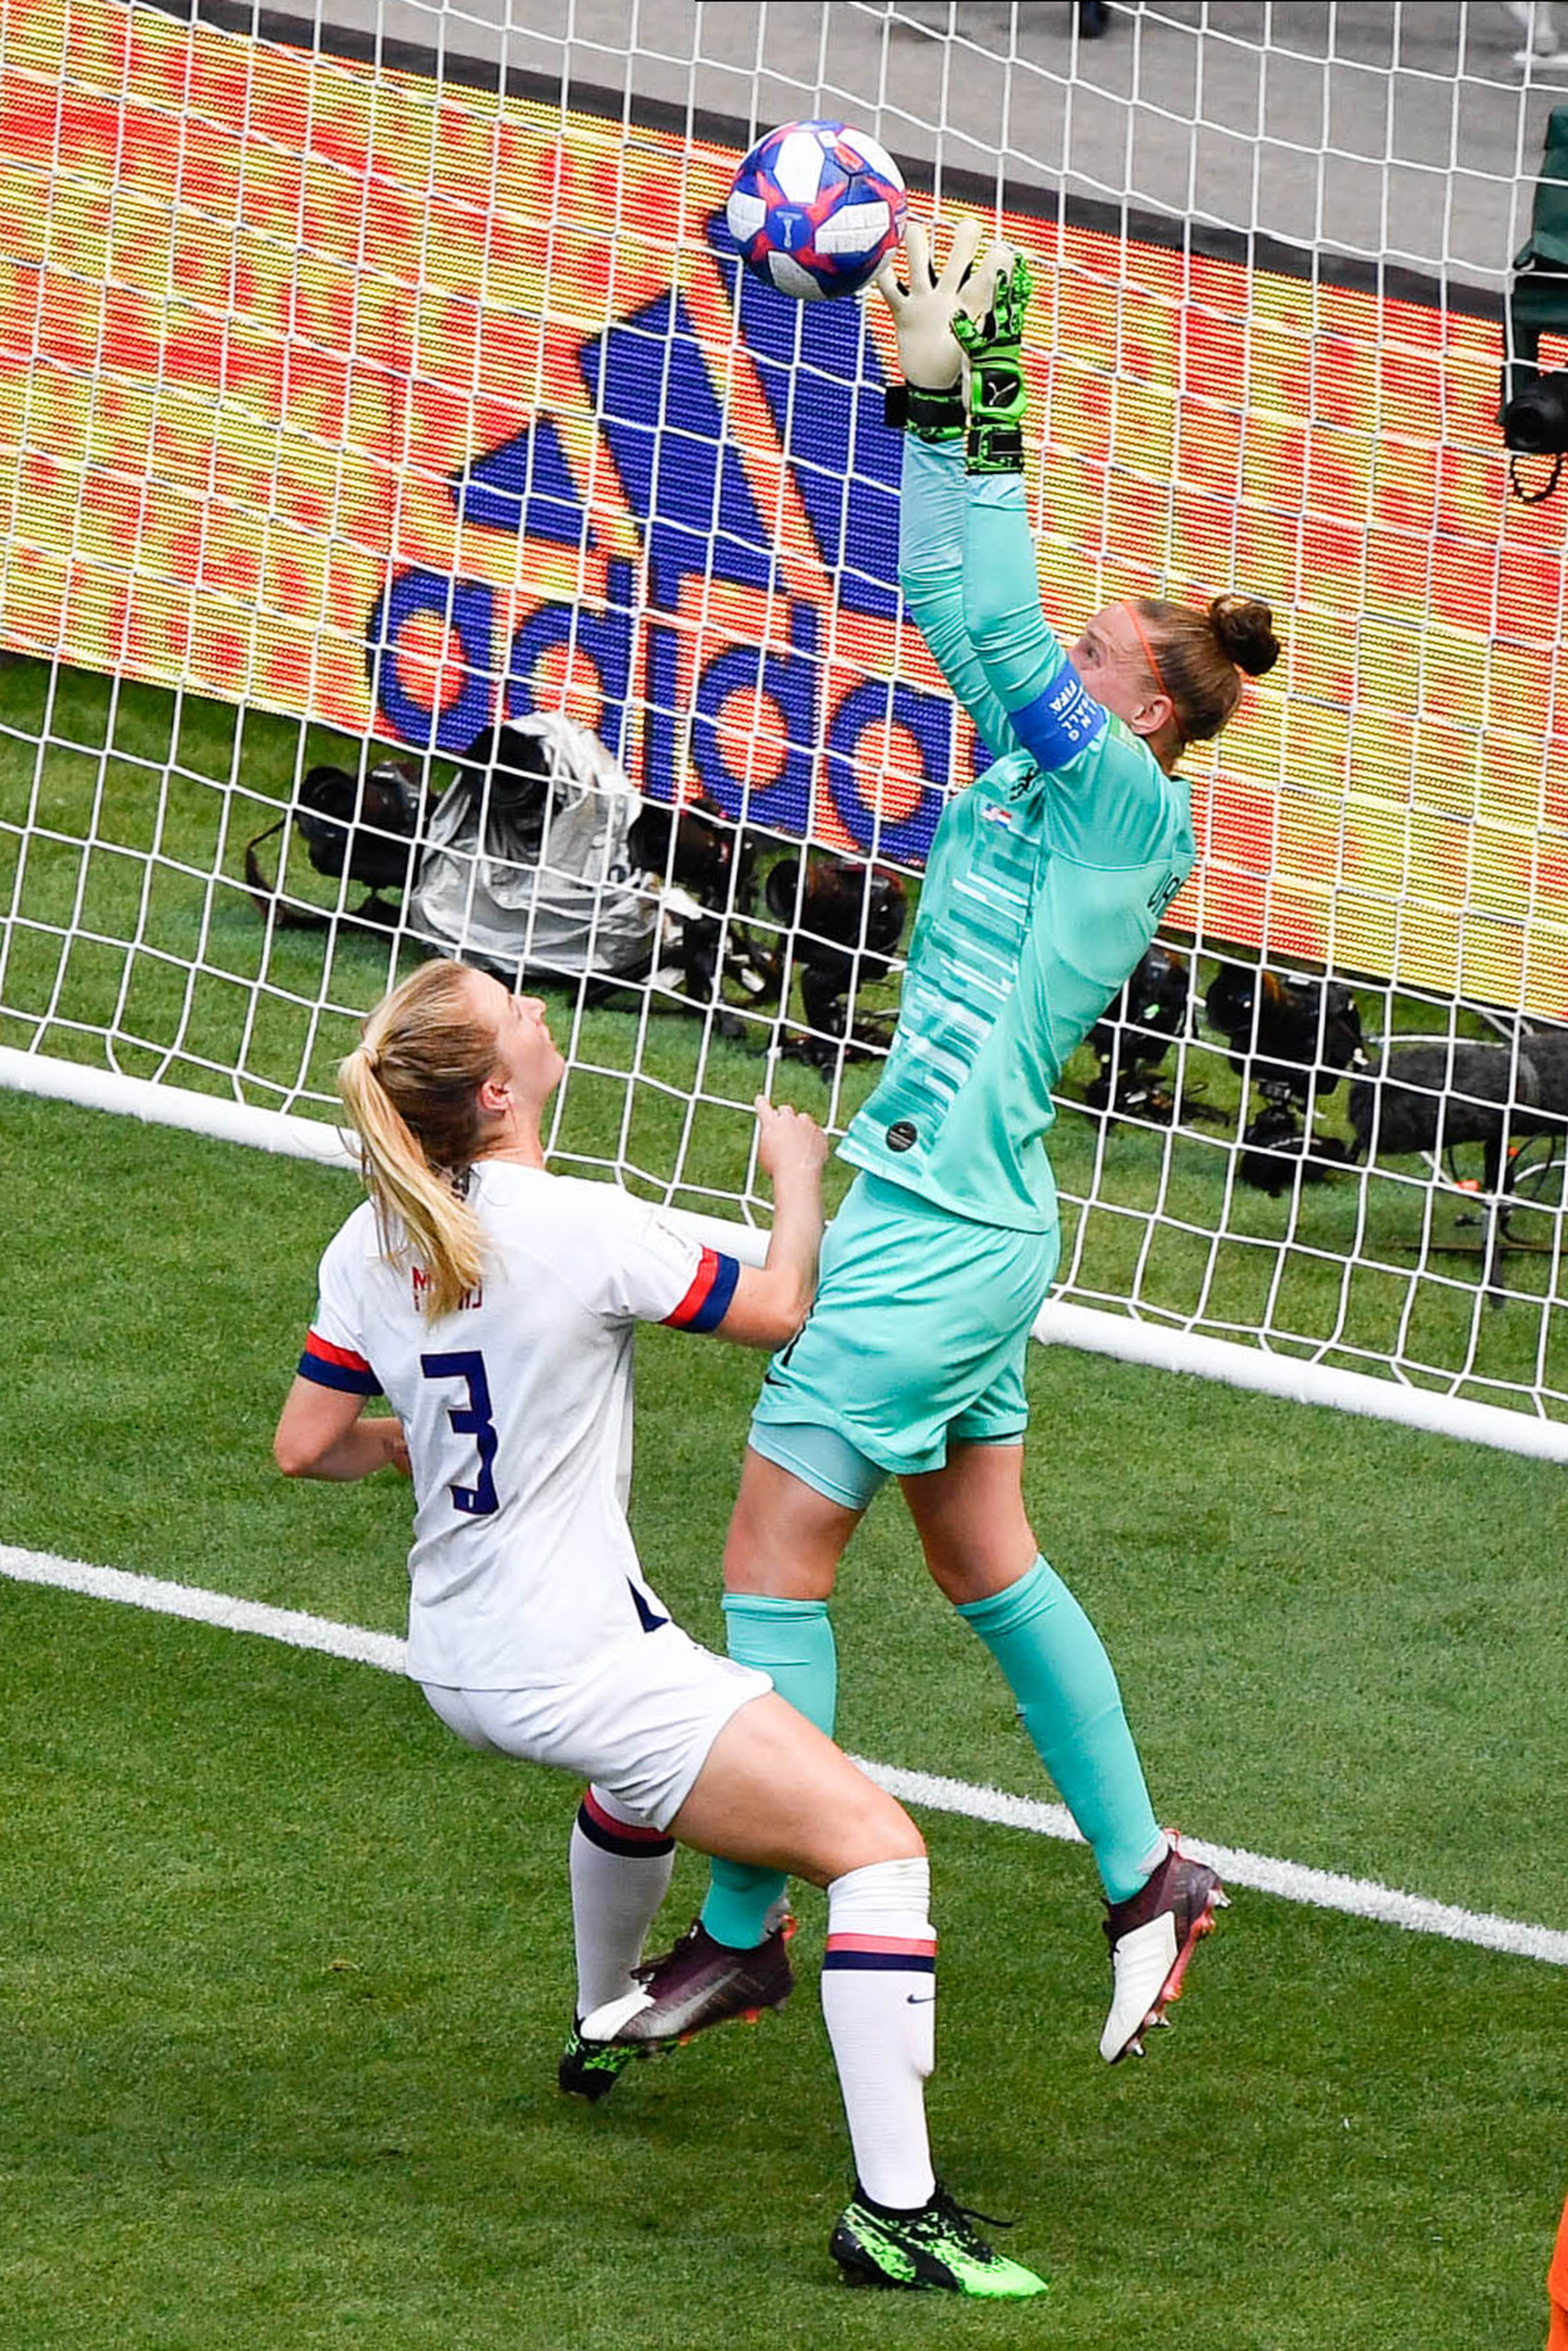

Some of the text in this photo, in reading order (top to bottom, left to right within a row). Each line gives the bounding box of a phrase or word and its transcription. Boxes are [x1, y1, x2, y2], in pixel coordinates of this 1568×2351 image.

[367, 554, 995, 860] adida
[1049, 679, 1077, 712] FIFA
[1061, 695, 1090, 729] BALL
[420, 1350, 499, 1515] 3
